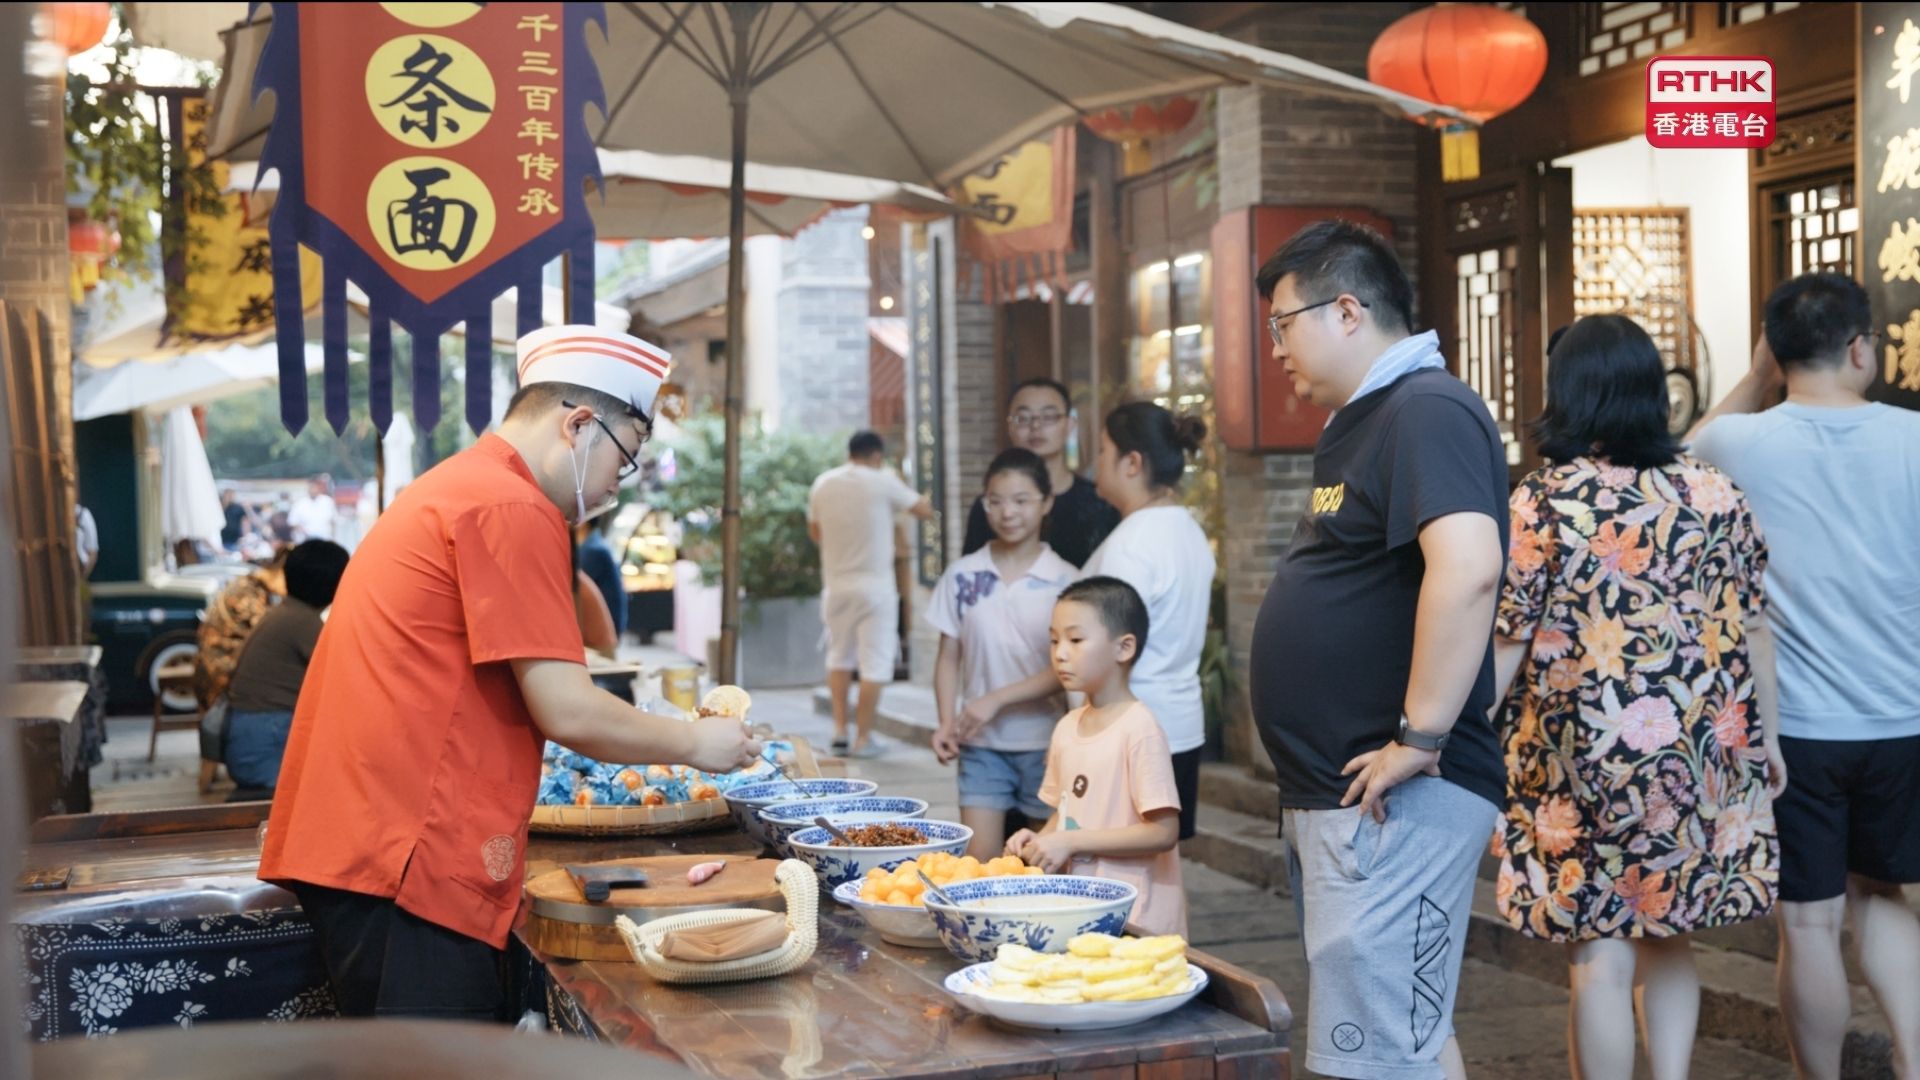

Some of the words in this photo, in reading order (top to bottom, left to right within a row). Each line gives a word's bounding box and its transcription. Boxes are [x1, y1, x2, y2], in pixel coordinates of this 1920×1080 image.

[379, 2, 493, 264] 条面
[516, 14, 560, 216] 千三百年传承
